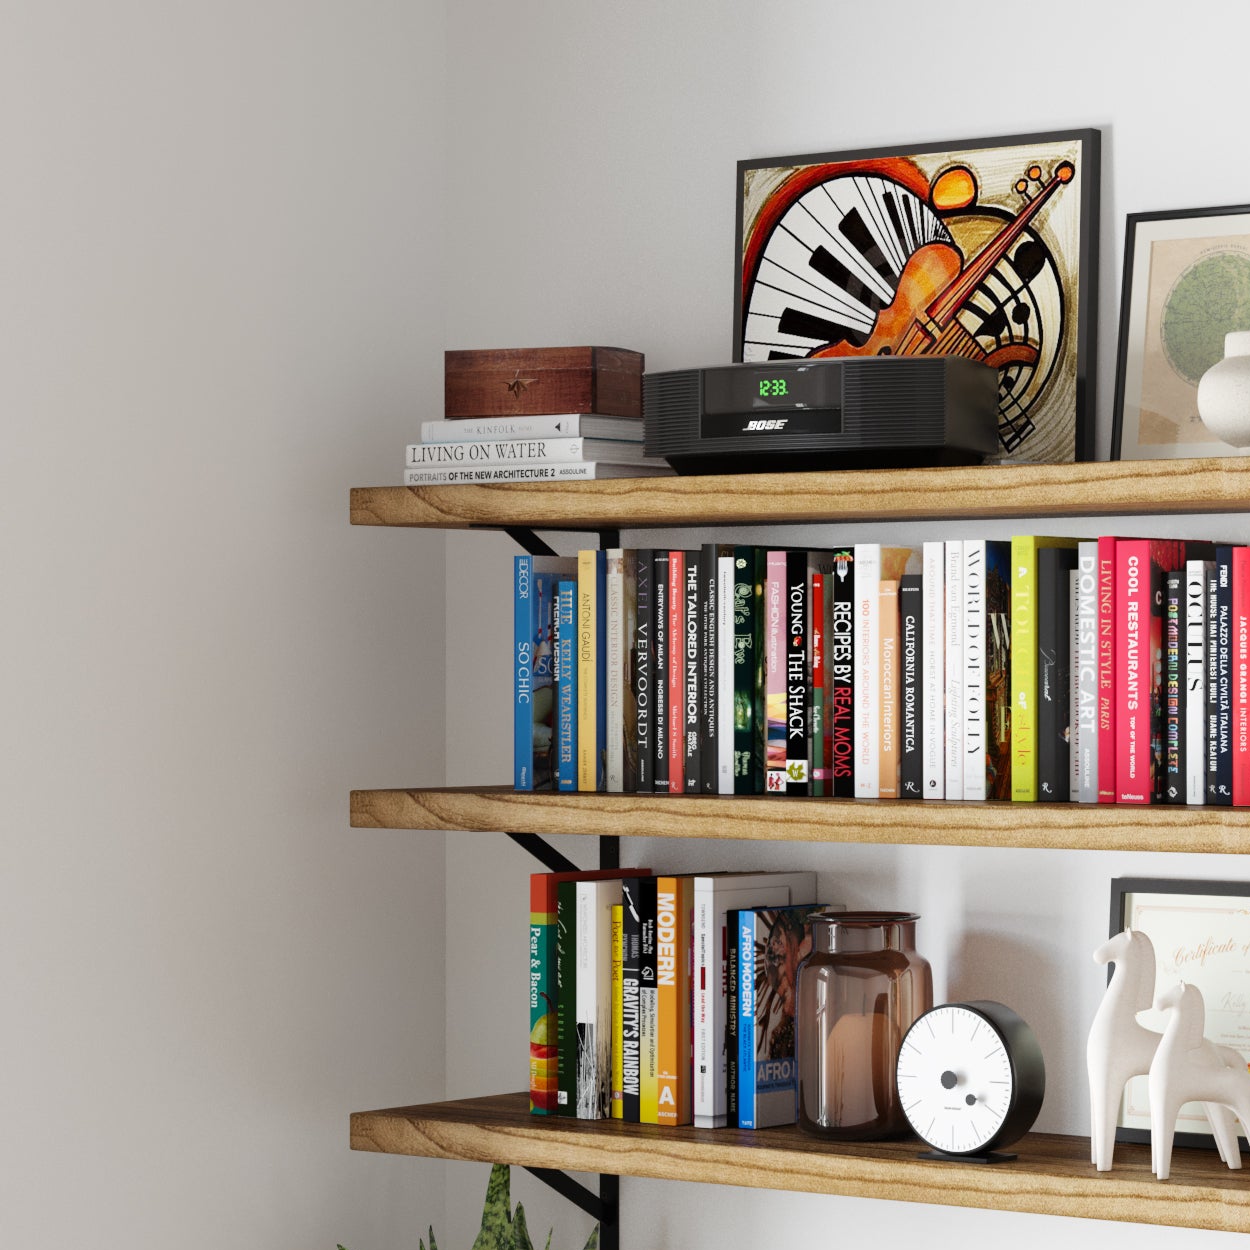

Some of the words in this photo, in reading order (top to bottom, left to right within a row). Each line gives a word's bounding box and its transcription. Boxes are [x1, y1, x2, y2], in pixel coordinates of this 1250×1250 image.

[475, 423, 516, 434] KINFOLK
[742, 419, 788, 430] BOSE
[411, 445, 464, 463] LIVING
[469, 444, 491, 461] ON
[496, 442, 547, 459] WATER
[408, 473, 447, 483] PORTRAITS
[448, 472, 458, 481] OF
[459, 471, 474, 480] THE
[474, 471, 491, 480] NEW
[493, 469, 549, 479] ARCHITECTURE
[550, 468, 555, 477] 2
[519, 563, 529, 599] DECOR
[637, 561, 648, 615] AXEL
[687, 565, 697, 591] THE
[967, 549, 980, 638] WORLD
[1100, 559, 1112, 614] LIVING
[1127, 555, 1139, 596] COOL
[1219, 564, 1228, 588] FENDI
[560, 589, 572, 624] HUE
[581, 593, 590, 629] ANTONI
[734, 583, 753, 625] Cat's
[770, 581, 780, 627] FASHION
[862, 599, 870, 616] 100
[1079, 555, 1096, 682] DOMESTIC
[657, 630, 664, 642] OF
[687, 593, 697, 658] TAILORED
[833, 601, 851, 661] RECIPES
[862, 619, 870, 666] INTERIORS
[1100, 618, 1112, 636] IN
[1167, 598, 1179, 671] POSTMODERN
[1187, 580, 1203, 692] OCULUS
[1220, 605, 1229, 645] PALAZZO
[1239, 615, 1248, 659] JACQUES
[518, 641, 530, 664] SO
[561, 639, 571, 680] KELLY
[581, 631, 594, 663] GAUDÍ
[734, 633, 753, 664] Eve
[770, 627, 780, 673] illustration
[789, 650, 805, 681] THE
[905, 615, 916, 684] CALIFORNIA
[967, 646, 980, 676] OF
[1100, 640, 1112, 689] STYLE
[1127, 601, 1139, 710] RESTAURANTS
[1220, 647, 1229, 676] DELLA
[518, 666, 530, 704] CHIC
[637, 622, 648, 749] VERVOORDT
[687, 661, 697, 724] INTERIOR
[833, 664, 851, 683] BY
[862, 668, 870, 709] AROUND
[1167, 673, 1179, 715] DESIGN
[1220, 677, 1230, 710] CIVILTÀ
[1239, 663, 1248, 704] GRANGE
[561, 684, 571, 763] WEARSTLER
[657, 716, 664, 725] DI
[789, 685, 805, 740] SHACK
[833, 686, 851, 724] REAL
[862, 712, 870, 729] THE
[905, 687, 916, 753] ROMANTICA
[967, 685, 980, 754] FOLLY
[1079, 690, 1096, 733] ART
[1100, 697, 1110, 730] PARIS
[862, 732, 870, 764] WORLD
[1129, 731, 1136, 740] OF
[1167, 717, 1179, 774] COMPLETE
[1220, 712, 1229, 753] ITALIANA
[1239, 707, 1248, 752] INTERIORS
[833, 727, 851, 777] MOMS
[530, 927, 541, 957] Pear
[631, 934, 640, 959] THOMAS
[657, 892, 675, 985] MODERN
[742, 926, 752, 962] AFRO
[1173, 936, 1237, 969] Certificate
[530, 960, 541, 969] &
[728, 948, 737, 992] BALANCED
[530, 972, 541, 1008] Bacon
[623, 977, 639, 1038] GRAVITY'S
[742, 963, 752, 1017] MODERN
[728, 995, 737, 1037] MINISTRY
[623, 1040, 639, 1096] RAINBOW
[658, 1086, 675, 1106] A
